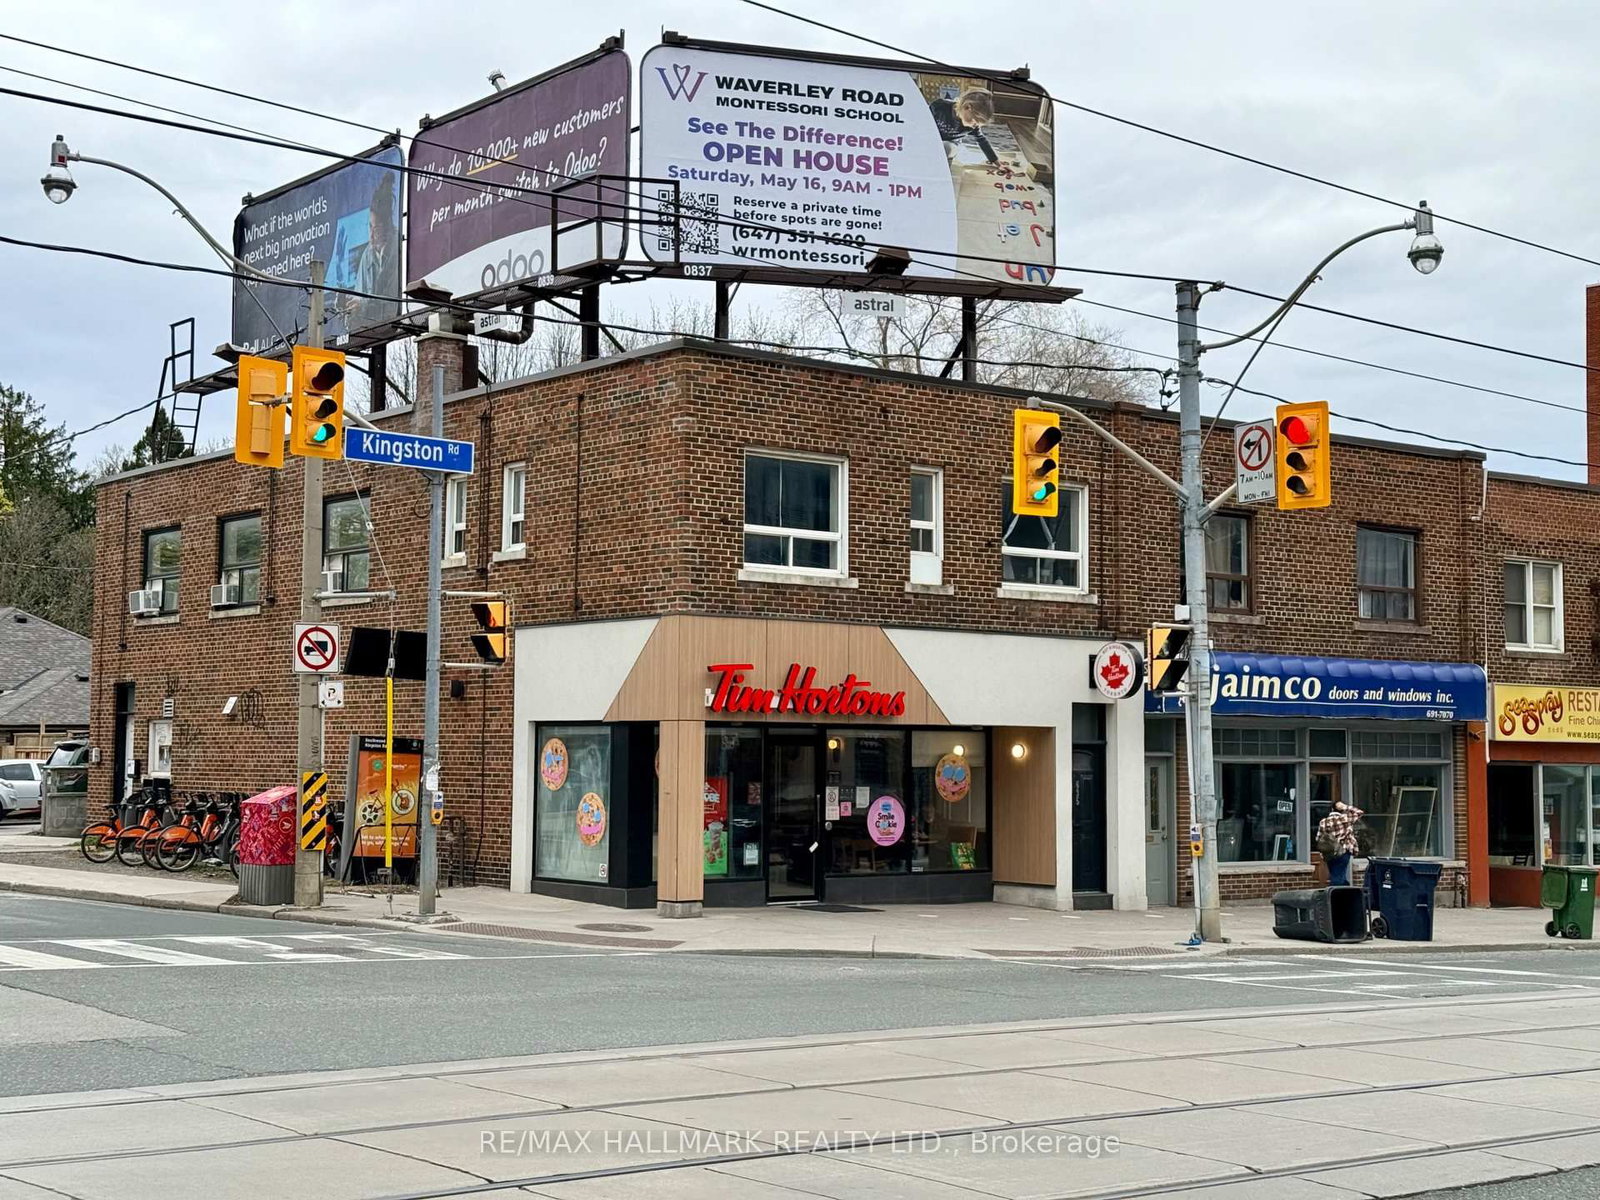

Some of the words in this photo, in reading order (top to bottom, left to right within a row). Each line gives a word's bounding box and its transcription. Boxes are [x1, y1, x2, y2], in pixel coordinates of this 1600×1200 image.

[715, 75, 835, 99] WAVERLEY
[842, 88, 905, 107] ROAD
[716, 96, 828, 116] MONTESSORI
[834, 107, 905, 123] SCHOOL
[416, 162, 444, 191] Why
[448, 154, 461, 176] do
[467, 136, 519, 171] 10,000+
[523, 128, 549, 149] new
[554, 96, 624, 138] customers
[688, 117, 728, 135] See
[735, 121, 776, 140] The
[783, 125, 903, 151] Difference!
[703, 141, 783, 168] OPEN
[793, 149, 889, 177] HOUSE
[430, 208, 450, 232] per
[454, 185, 493, 215] month
[498, 164, 540, 202] switch
[545, 160, 560, 187] to
[564, 136, 608, 180] Odoo?
[668, 165, 754, 187] Saturday,
[761, 173, 797, 191] May
[803, 176, 826, 192] 16,
[832, 179, 871, 194] 9AM
[888, 183, 922, 198] 1PM
[244, 219, 268, 243] What
[269, 215, 277, 233] if
[277, 212, 293, 230] the
[294, 195, 328, 223] world's
[733, 196, 786, 210] Reserve
[790, 202, 798, 210] a
[802, 202, 848, 214] private
[852, 205, 882, 217] time
[733, 209, 777, 222] before
[781, 214, 817, 225] spots
[821, 217, 841, 227] are
[846, 220, 882, 230] gone!
[243, 245, 264, 266] next
[265, 239, 280, 259] big
[281, 222, 330, 251] innovation
[732, 223, 780, 244] (647)
[290, 245, 316, 271] here?
[481, 248, 545, 291] odoo
[683, 265, 713, 277] 0837
[854, 298, 894, 311] astral
[362, 432, 443, 462] Kingston
[447, 443, 460, 455] Rd
[707, 663, 775, 713] Tim
[777, 662, 906, 716] Hortons
[1210, 664, 1322, 706] jaimco
[1328, 686, 1359, 700] doors
[1363, 687, 1384, 700] and
[1388, 688, 1432, 703] windows
[1436, 689, 1454, 703] inc.
[1568, 715, 1585, 726] Fine
[875, 820, 897, 829] Ckie
[877, 812, 895, 821] Smile
